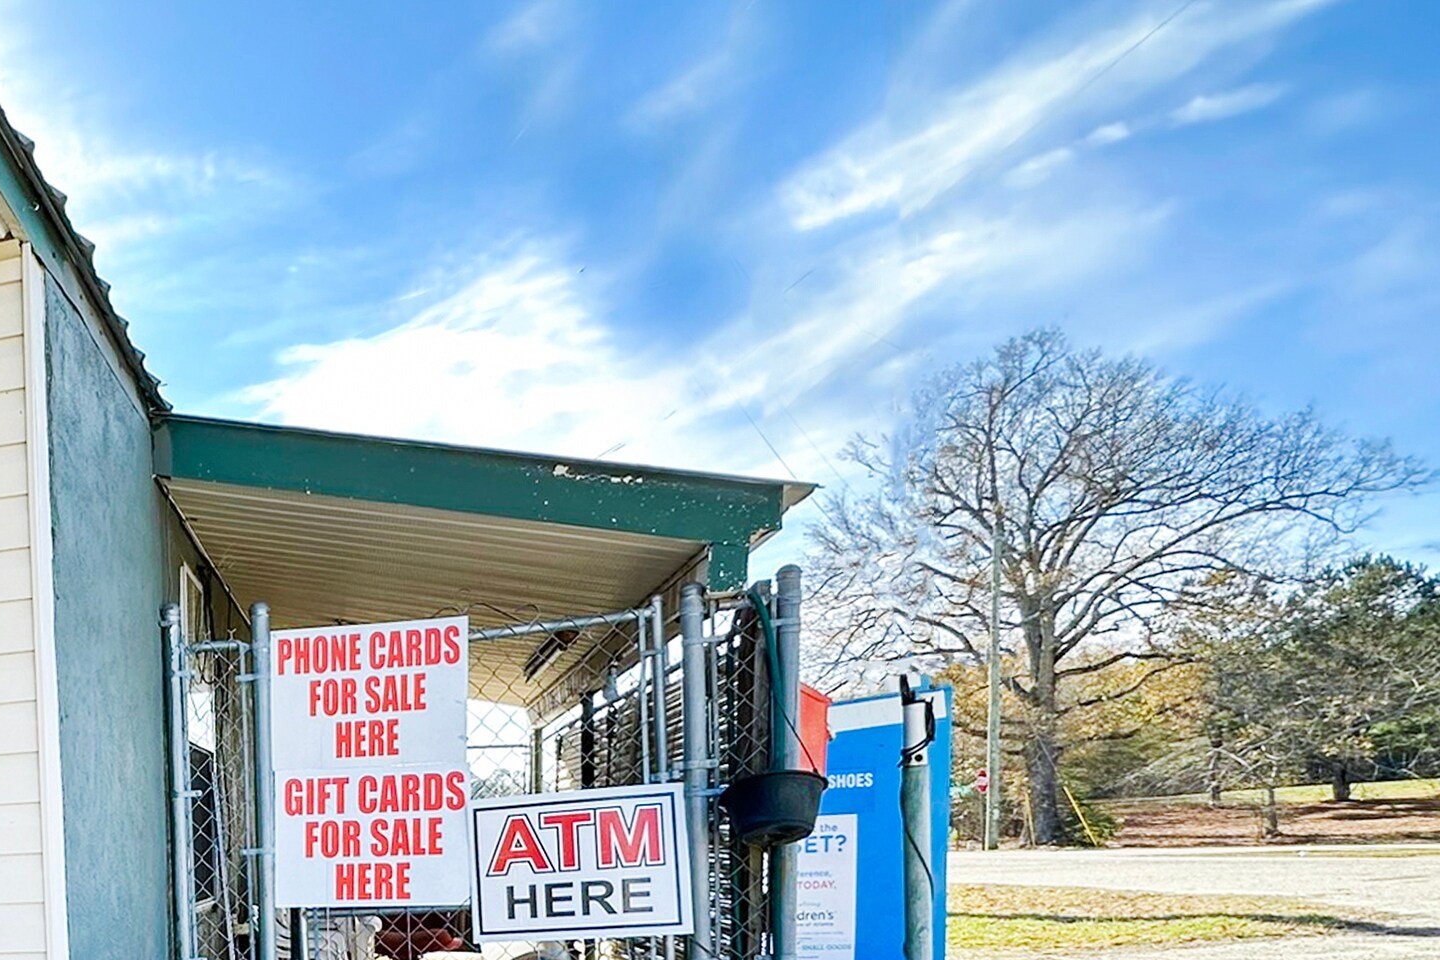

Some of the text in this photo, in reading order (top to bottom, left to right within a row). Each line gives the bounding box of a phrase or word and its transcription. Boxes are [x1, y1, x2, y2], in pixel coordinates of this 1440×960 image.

[277, 625, 461, 676] PHONE CARDS
[309, 672, 427, 717] FOR SALE
[335, 718, 400, 759] HERE
[284, 770, 467, 817] GIFT CARDS
[828, 772, 874, 789] SHOES
[304, 817, 444, 859] FOR SALE
[485, 802, 667, 878] ATM
[797, 834, 847, 853] ET?
[820, 824, 838, 833] the
[335, 862, 412, 901] HERE
[506, 877, 654, 921] HERE
[795, 909, 834, 921] dren's
